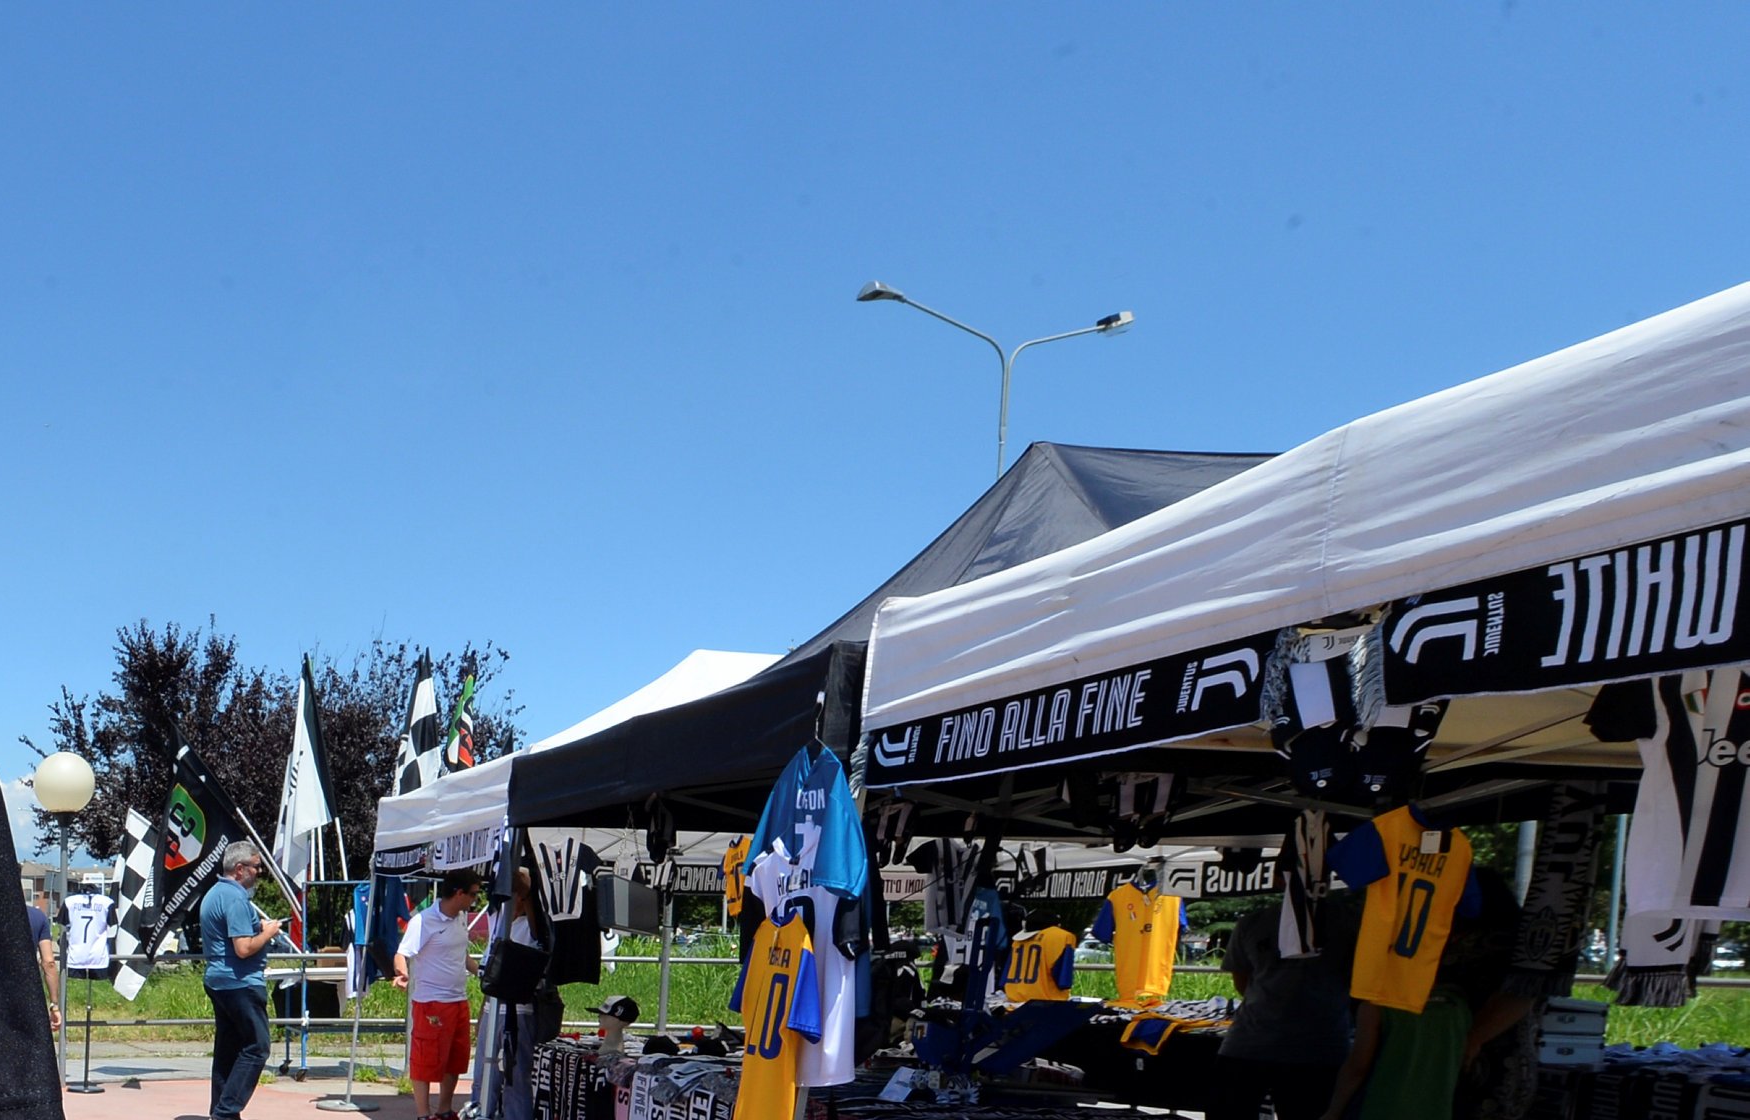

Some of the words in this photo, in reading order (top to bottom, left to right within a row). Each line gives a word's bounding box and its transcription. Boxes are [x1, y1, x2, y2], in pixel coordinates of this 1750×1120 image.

[1176, 661, 1199, 714] JUVENTUS
[934, 707, 996, 765] FINO
[998, 688, 1072, 753] ALLA
[1076, 669, 1152, 738] FINE
[908, 725, 921, 764] JUVENTUS
[81, 915, 93, 944] 7
[1004, 944, 1042, 985] 10
[634, 1074, 648, 1117] FINE
